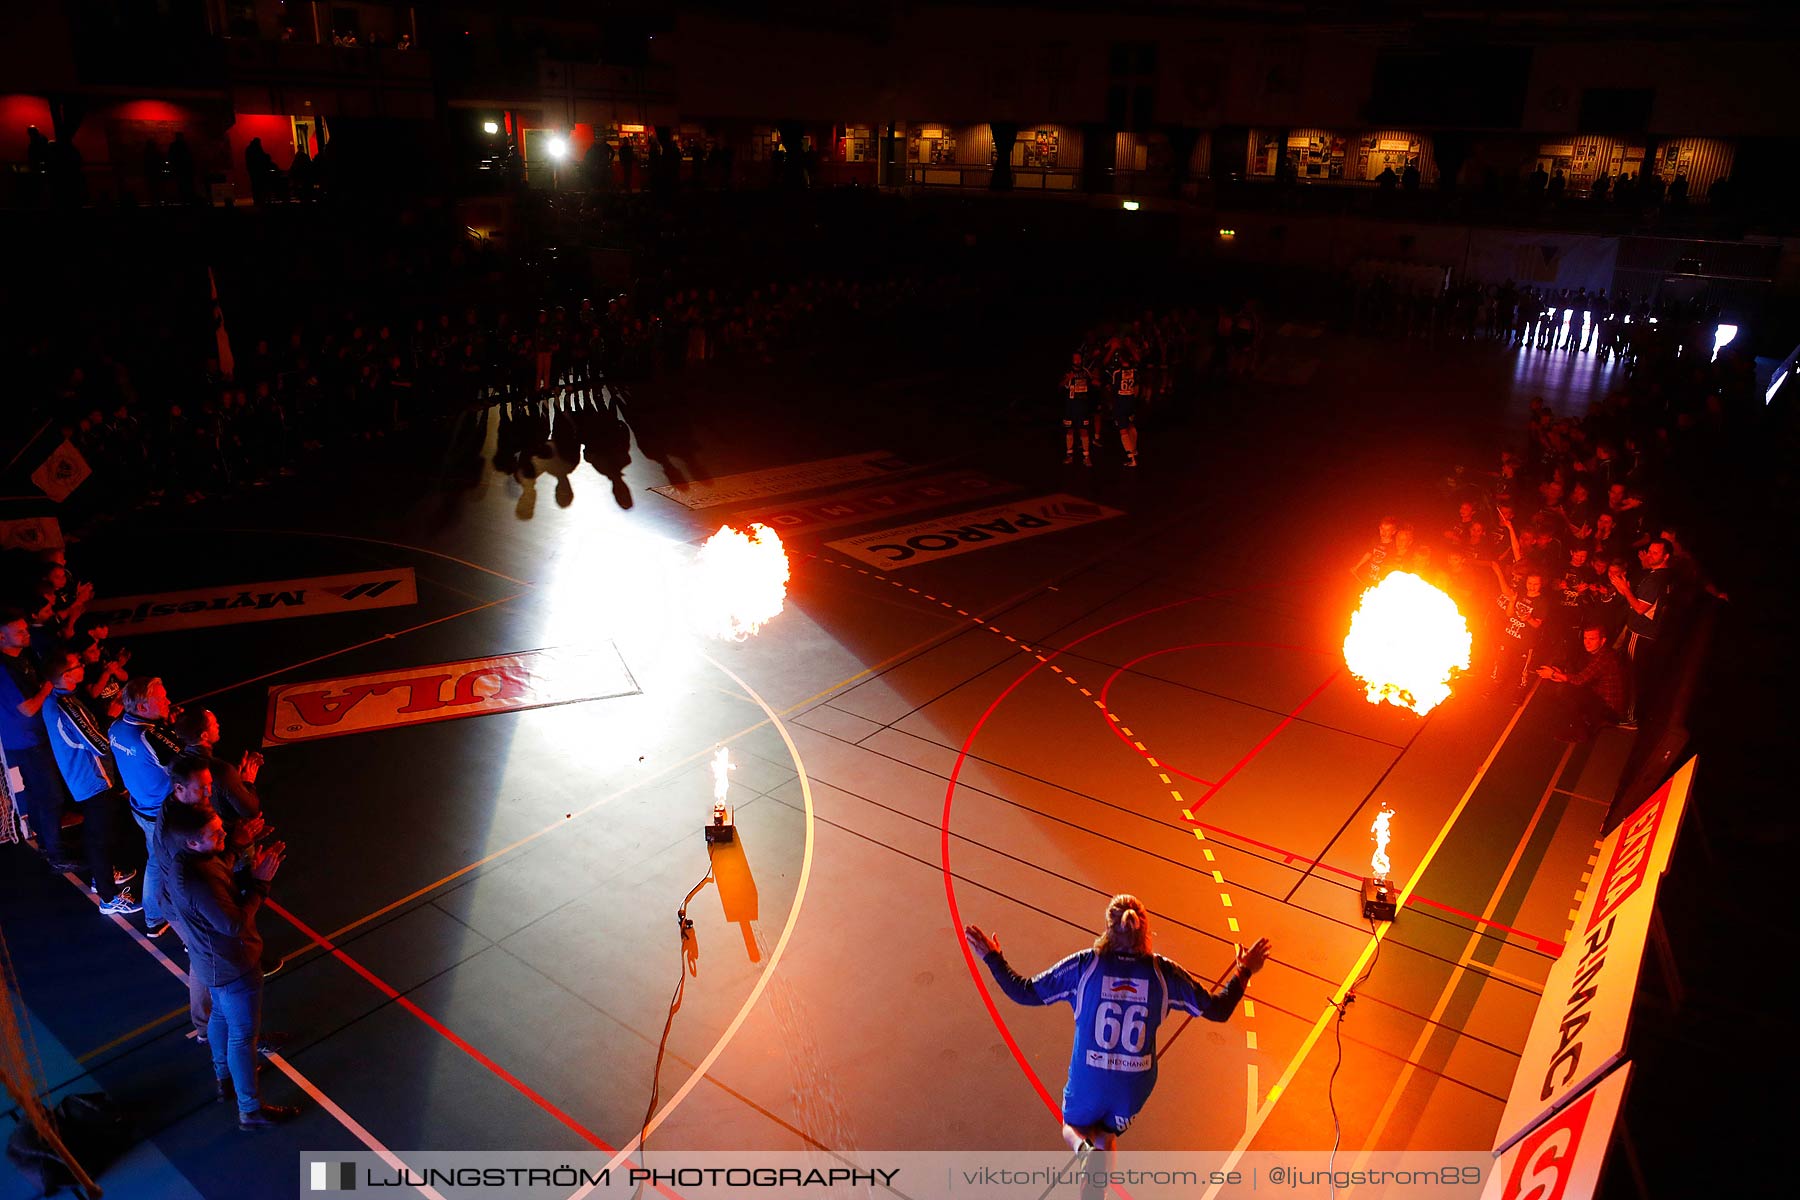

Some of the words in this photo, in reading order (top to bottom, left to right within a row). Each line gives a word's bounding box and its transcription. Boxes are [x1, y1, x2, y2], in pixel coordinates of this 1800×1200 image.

[866, 512, 1050, 563] PAROC
[1597, 801, 1660, 918] EXTRA
[1095, 1001, 1149, 1054] 66
